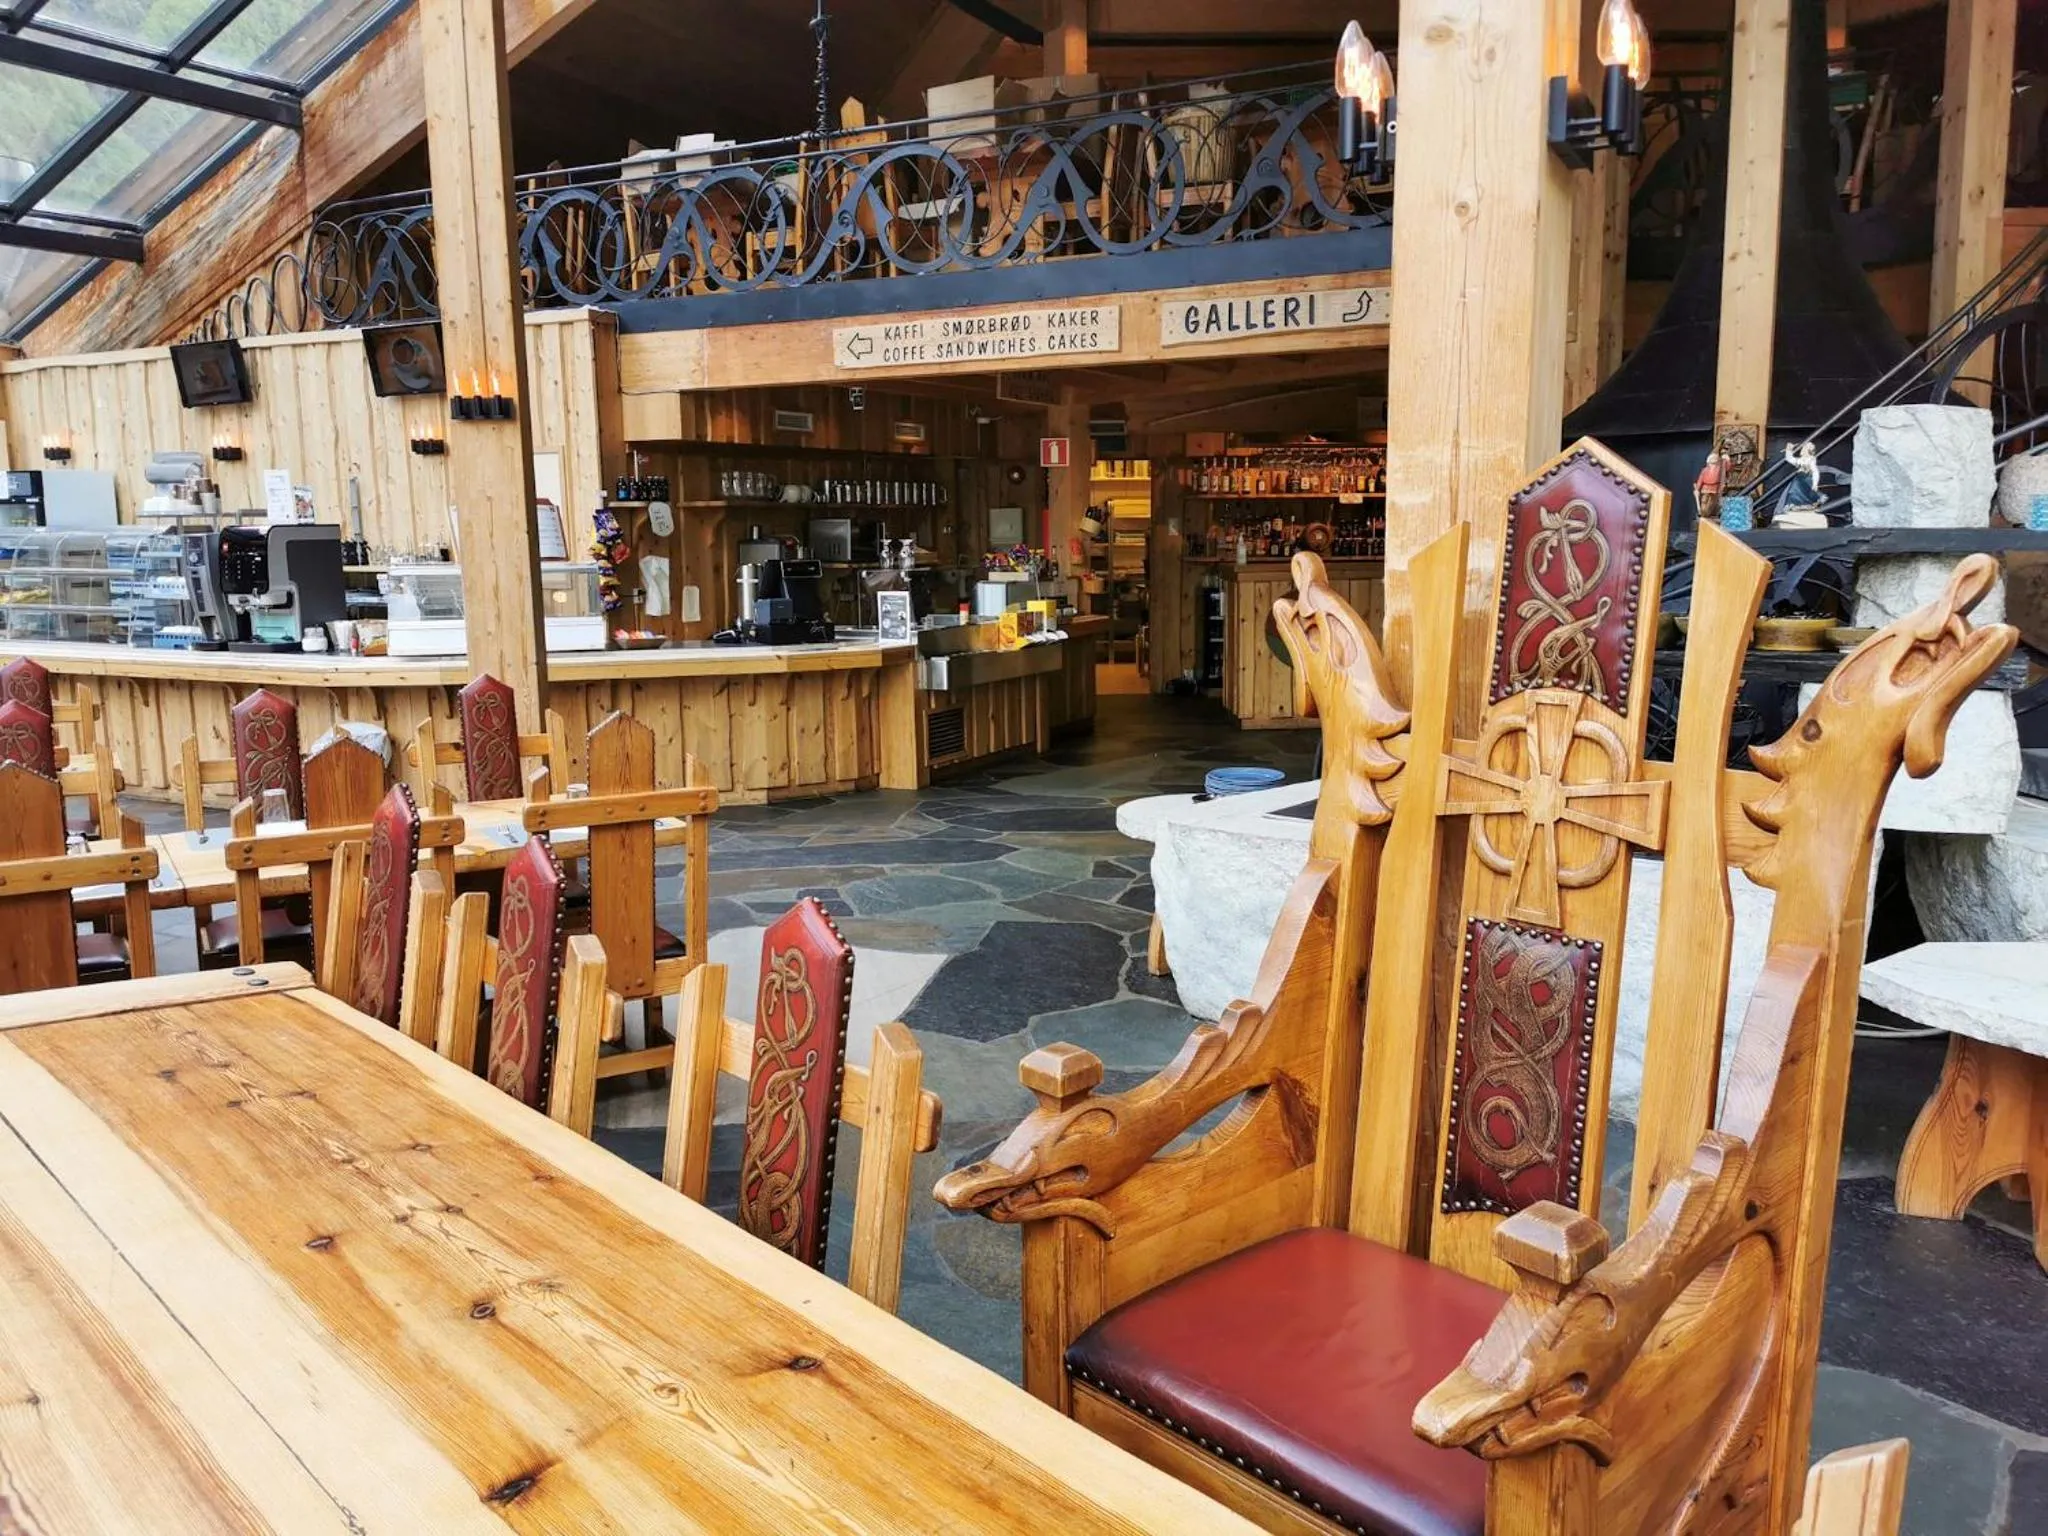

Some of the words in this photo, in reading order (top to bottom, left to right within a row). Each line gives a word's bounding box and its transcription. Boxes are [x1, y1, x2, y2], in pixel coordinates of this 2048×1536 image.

[884, 324, 924, 341] KAFFI
[942, 315, 1032, 337] SMØRBRØD
[1047, 310, 1100, 328] KAKER
[1184, 294, 1315, 334] GALLERI
[883, 345, 925, 362] COFFE
[936, 337, 1036, 358] SANDWICHES
[1047, 333, 1098, 350] CAKES
